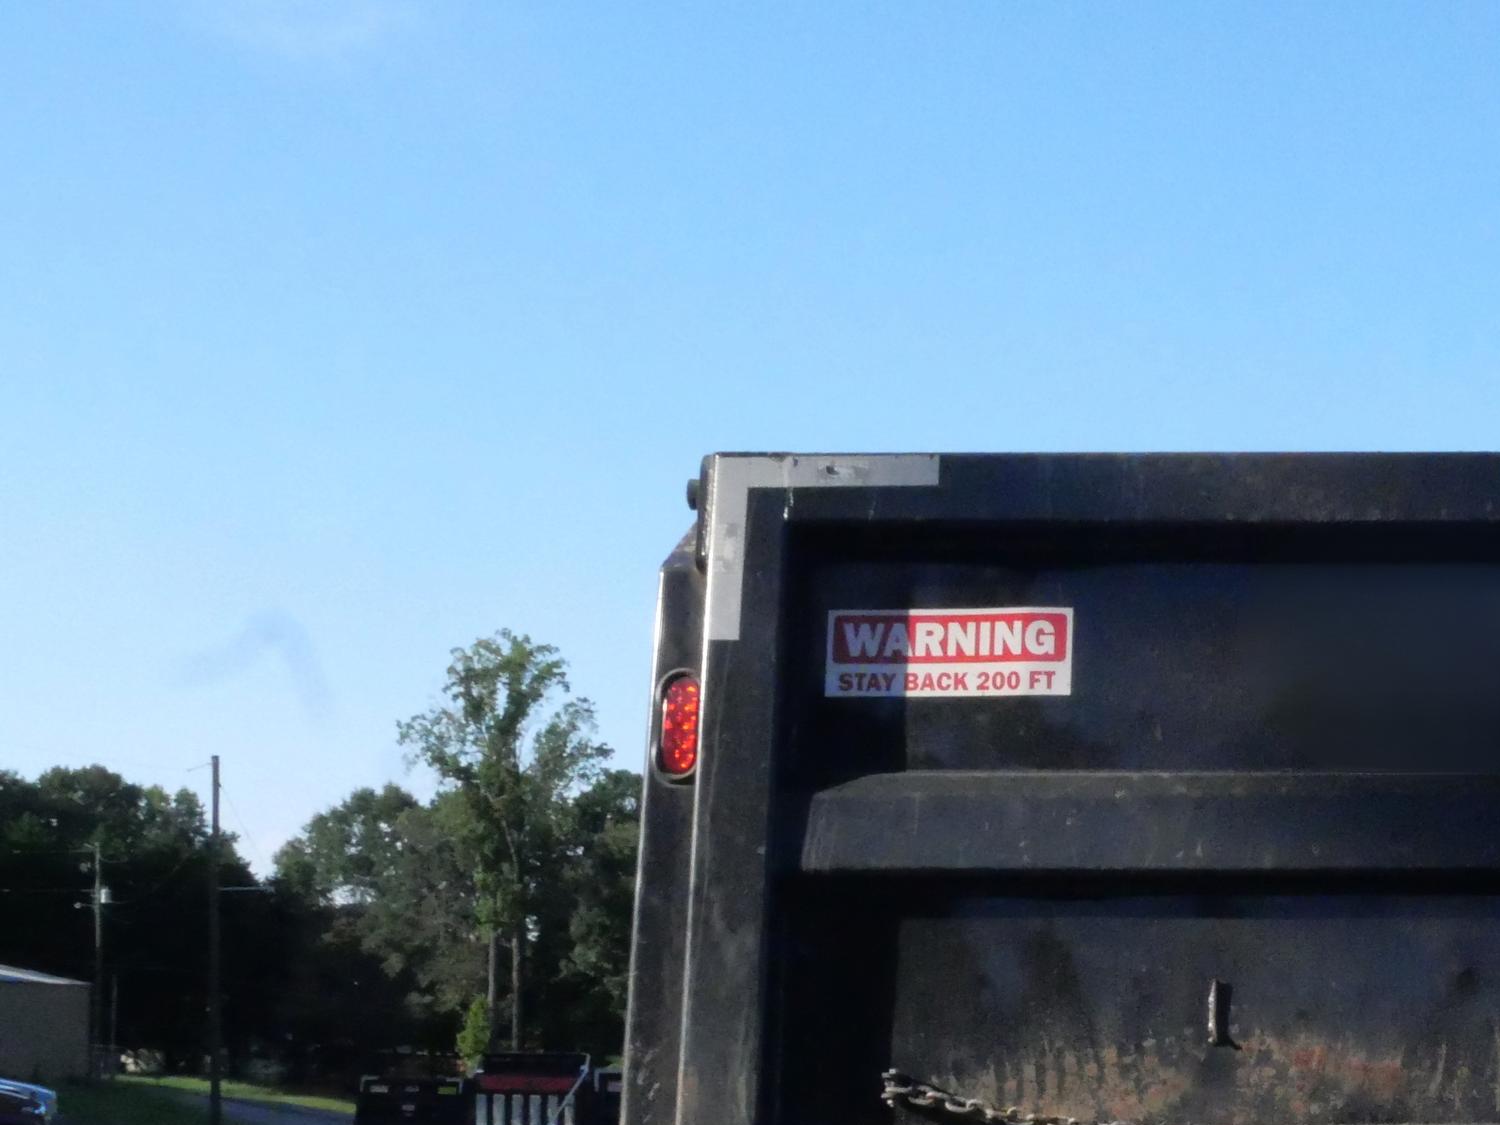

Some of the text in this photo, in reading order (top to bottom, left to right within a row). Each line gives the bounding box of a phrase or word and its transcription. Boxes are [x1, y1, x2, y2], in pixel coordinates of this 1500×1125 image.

[843, 619, 1056, 657] WARNING
[838, 670, 1056, 691] STAY BACK 200 FT
